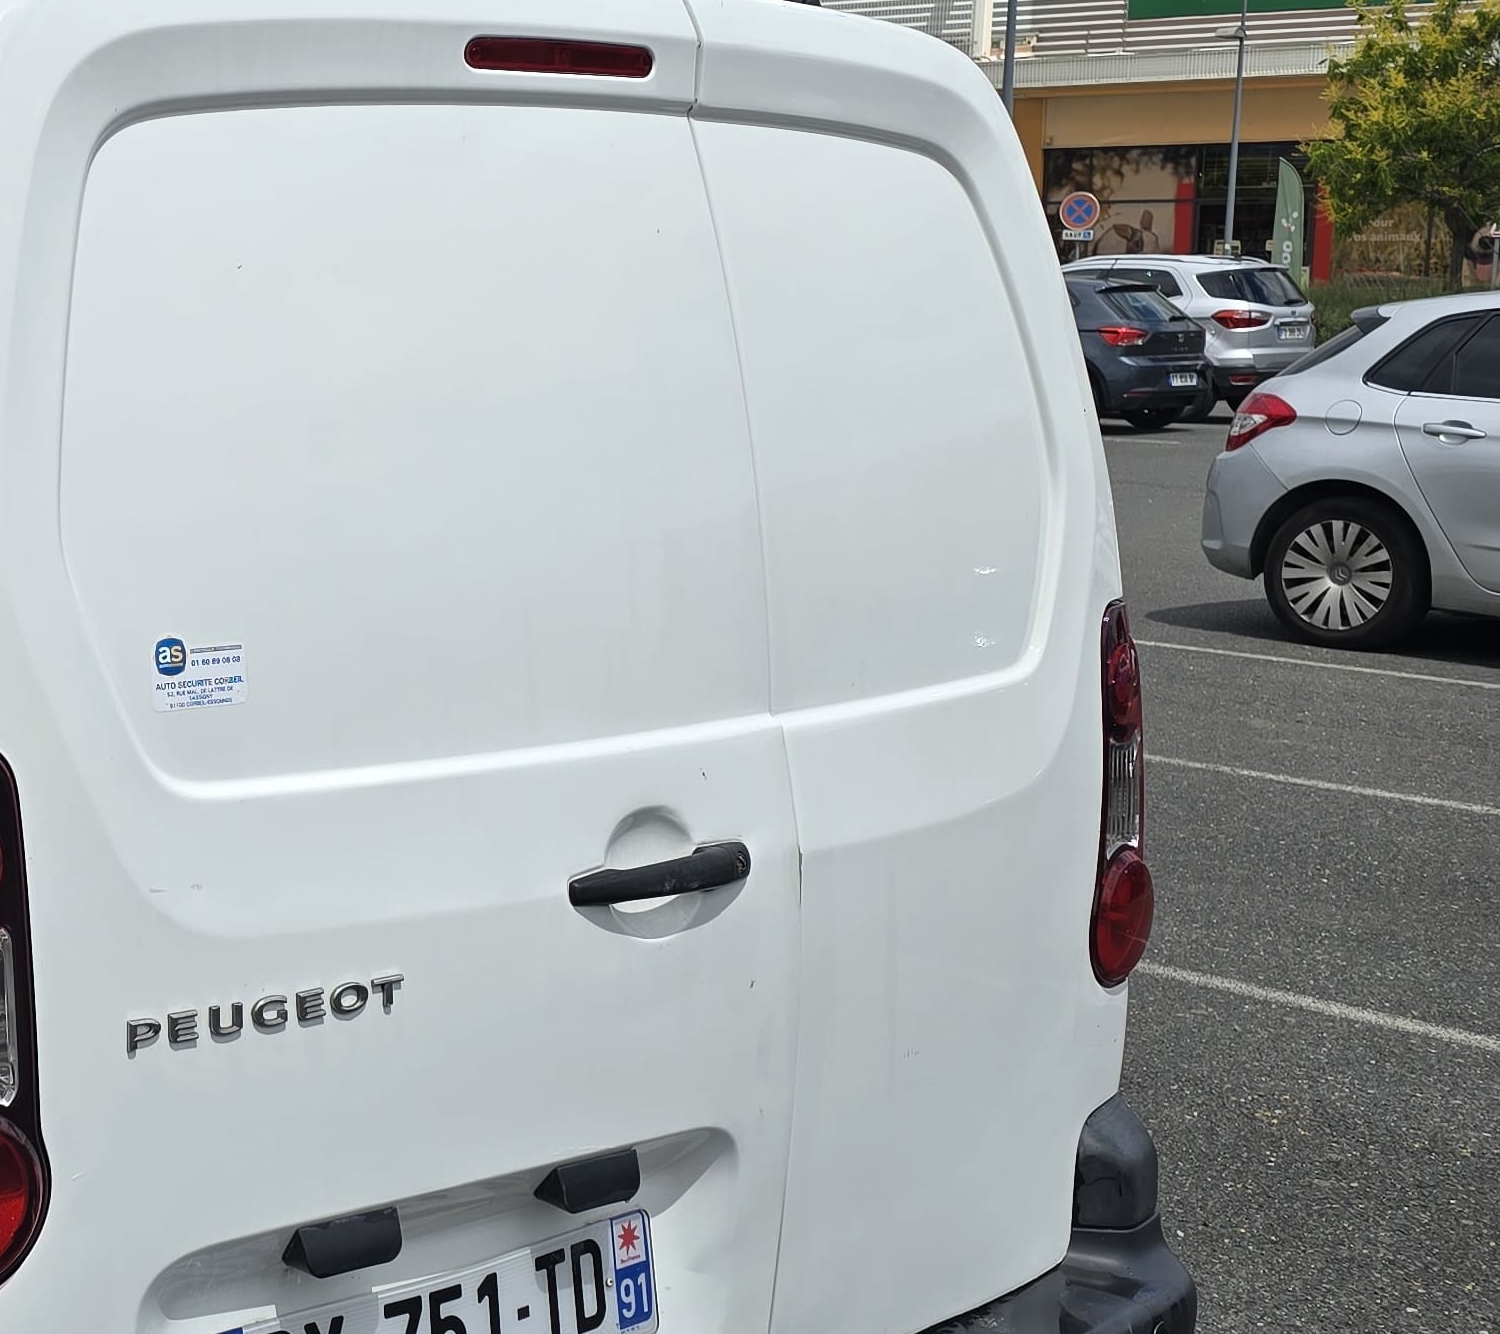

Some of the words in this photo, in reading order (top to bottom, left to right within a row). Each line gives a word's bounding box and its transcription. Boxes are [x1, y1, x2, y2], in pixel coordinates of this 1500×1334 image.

[159, 646, 183, 665] as
[156, 681, 176, 691] AUTO
[126, 973, 404, 1053] PEUGEOT
[620, 1272, 649, 1319] 91
